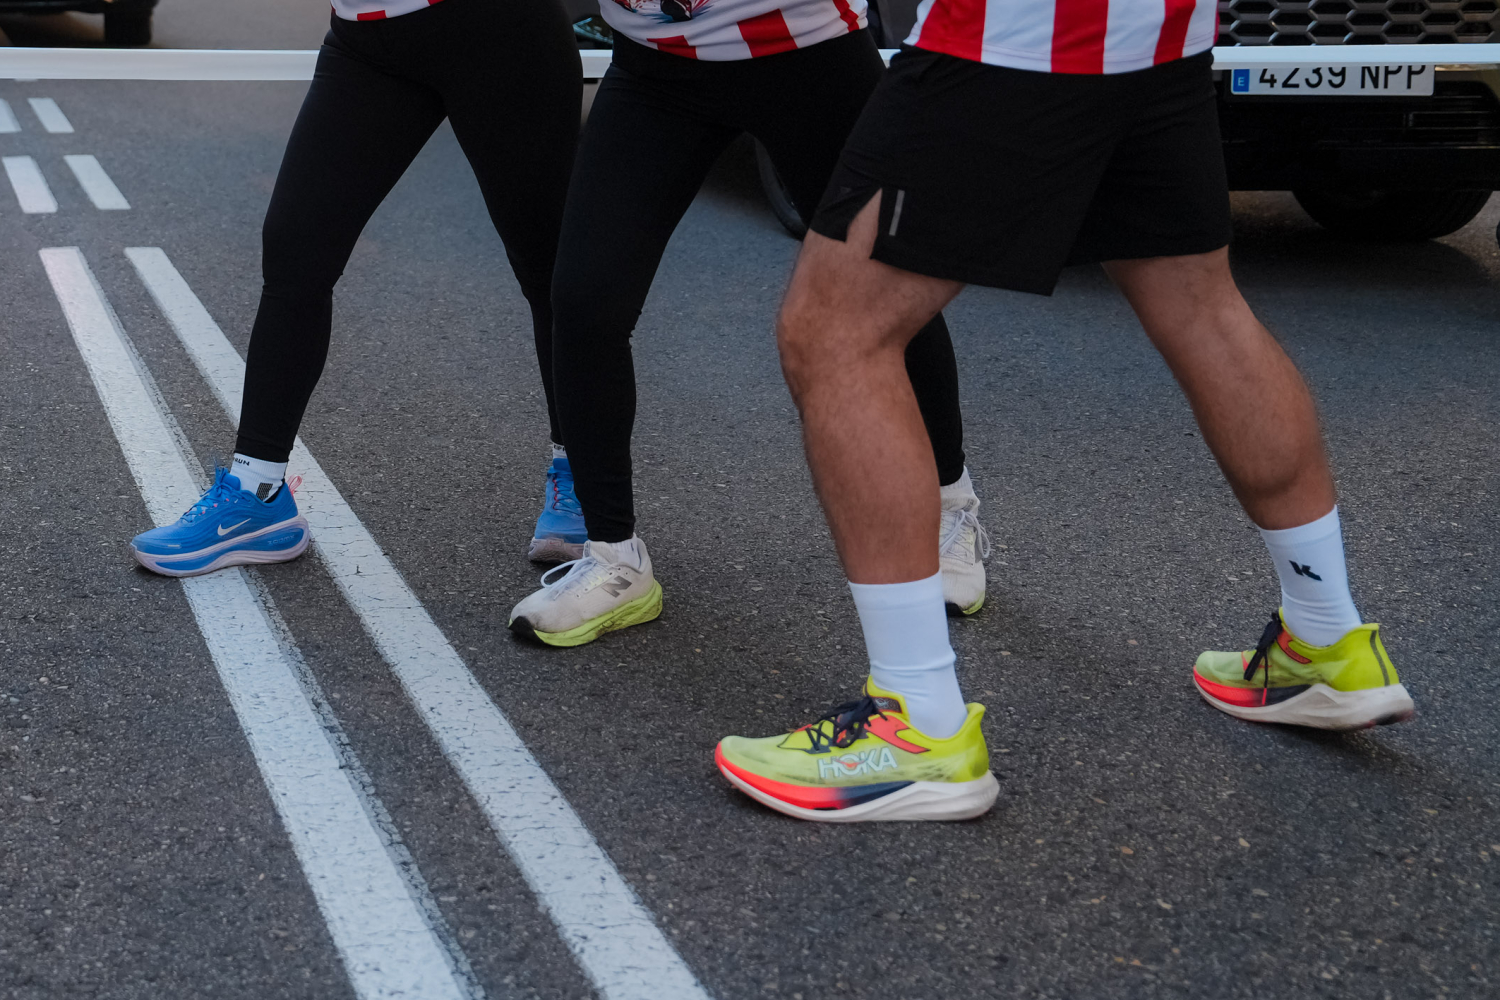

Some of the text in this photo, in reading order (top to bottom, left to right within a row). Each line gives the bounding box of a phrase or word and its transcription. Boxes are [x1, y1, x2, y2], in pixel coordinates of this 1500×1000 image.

[1259, 67, 1347, 89] 4239
[1360, 65, 1426, 89] NPP
[817, 746, 898, 778] HOKA
